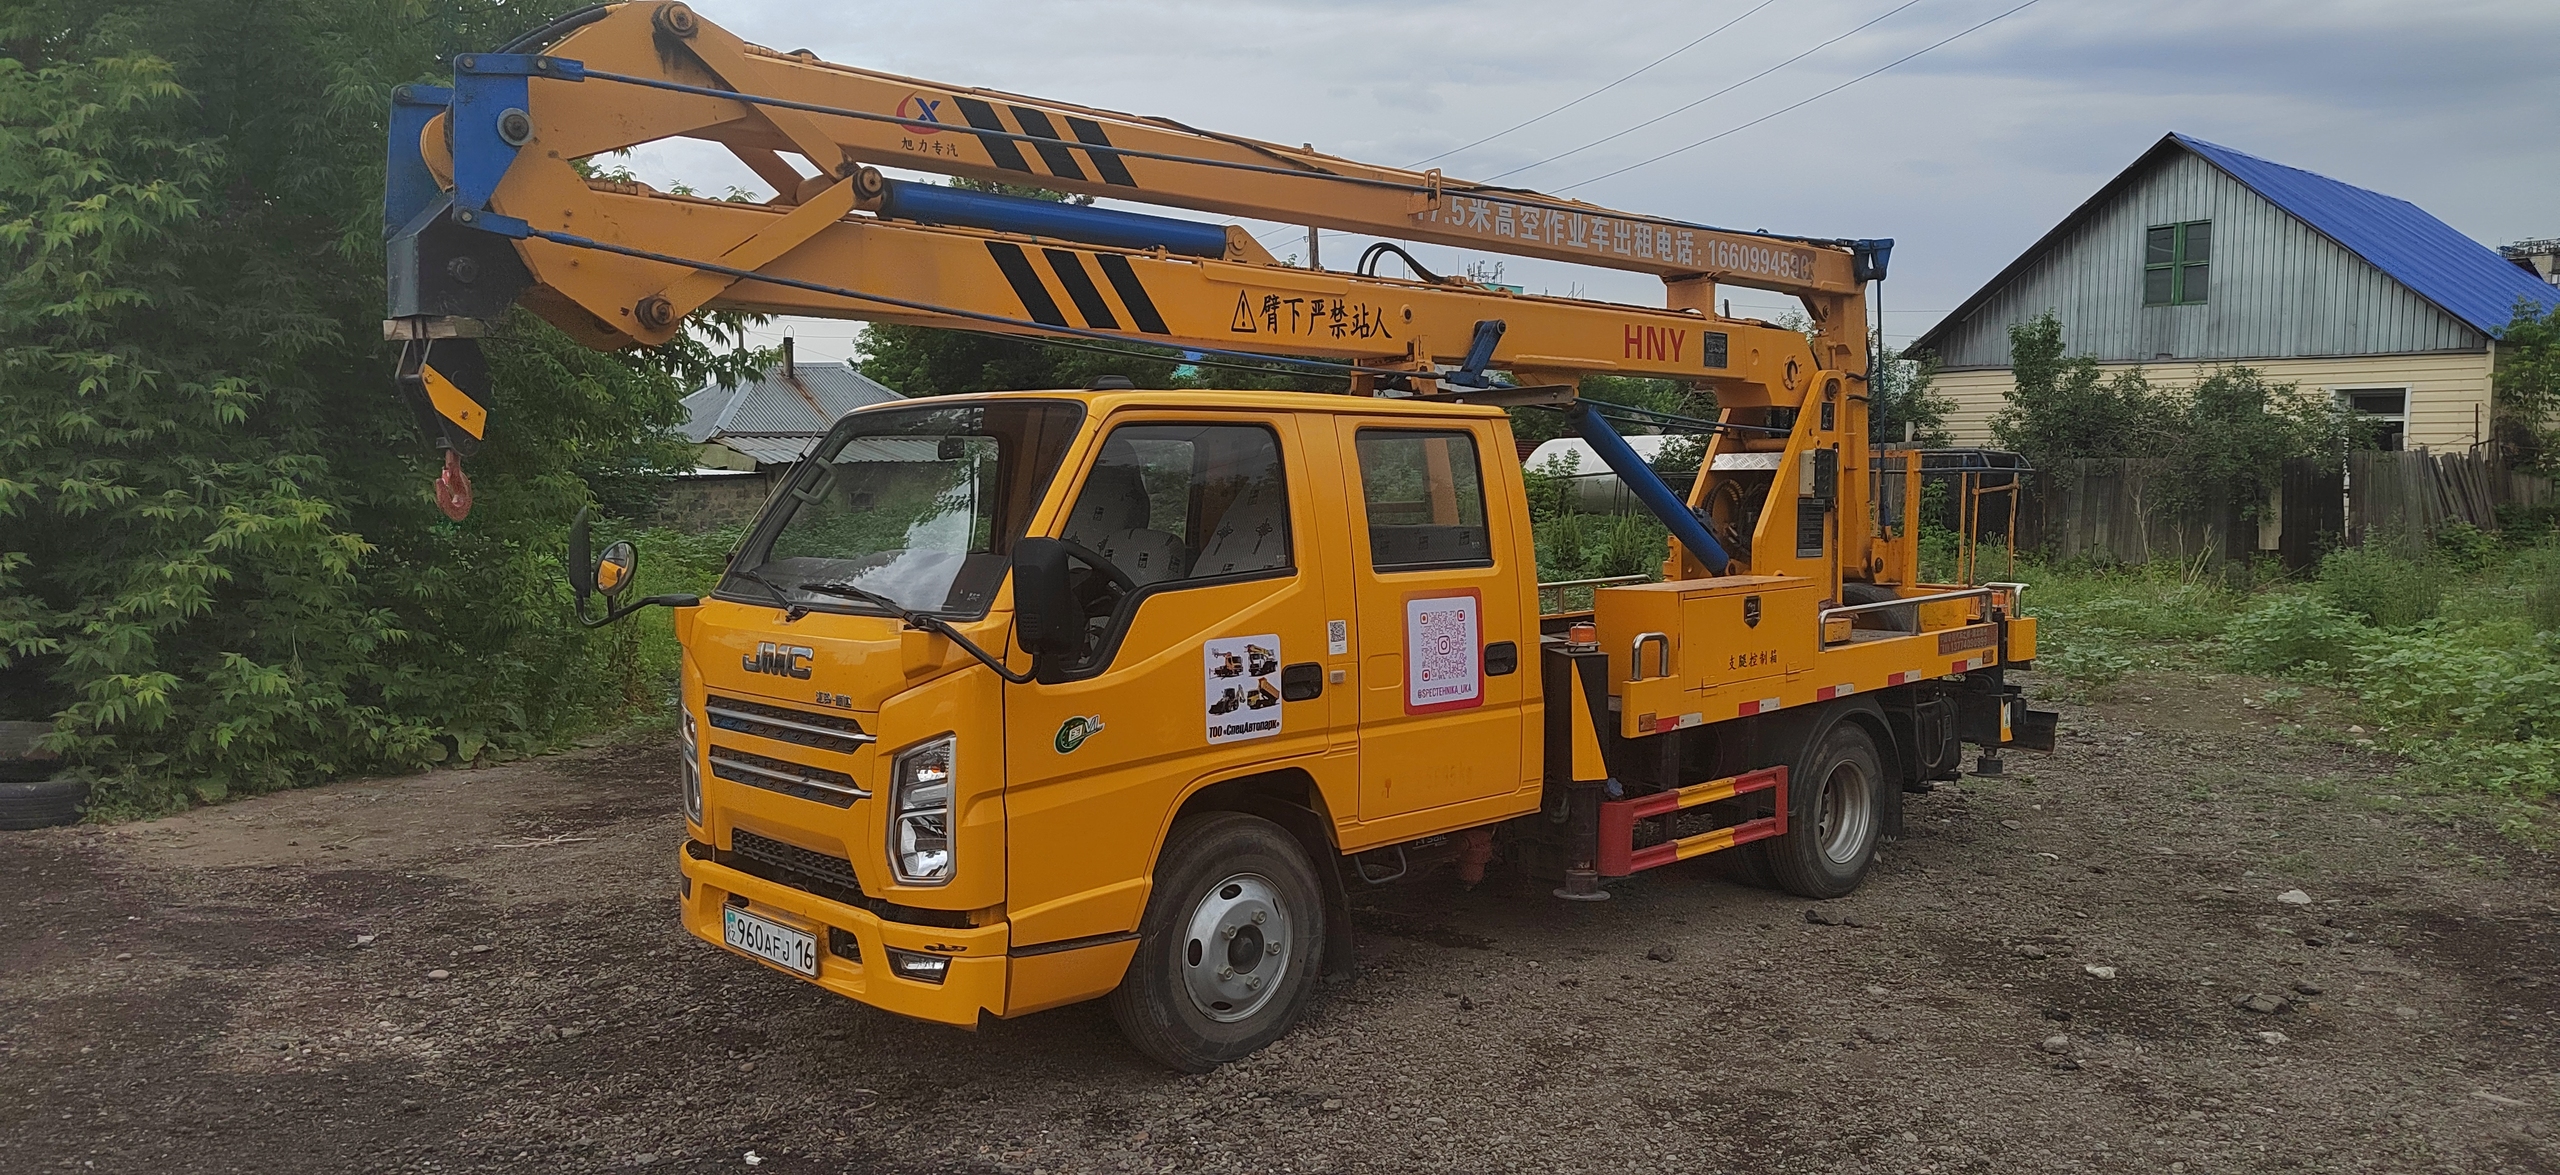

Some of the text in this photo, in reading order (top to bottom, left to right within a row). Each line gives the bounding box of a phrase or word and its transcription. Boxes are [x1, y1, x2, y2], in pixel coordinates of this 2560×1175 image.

[901, 136, 959, 157] 旭力专汽
[1259, 294, 1393, 340] 臂下严禁站人
[1624, 324, 1686, 363] HNY
[742, 641, 814, 680] JMC
[1209, 726, 1223, 738] ТОО
[737, 918, 814, 970] 960AFJ 16
